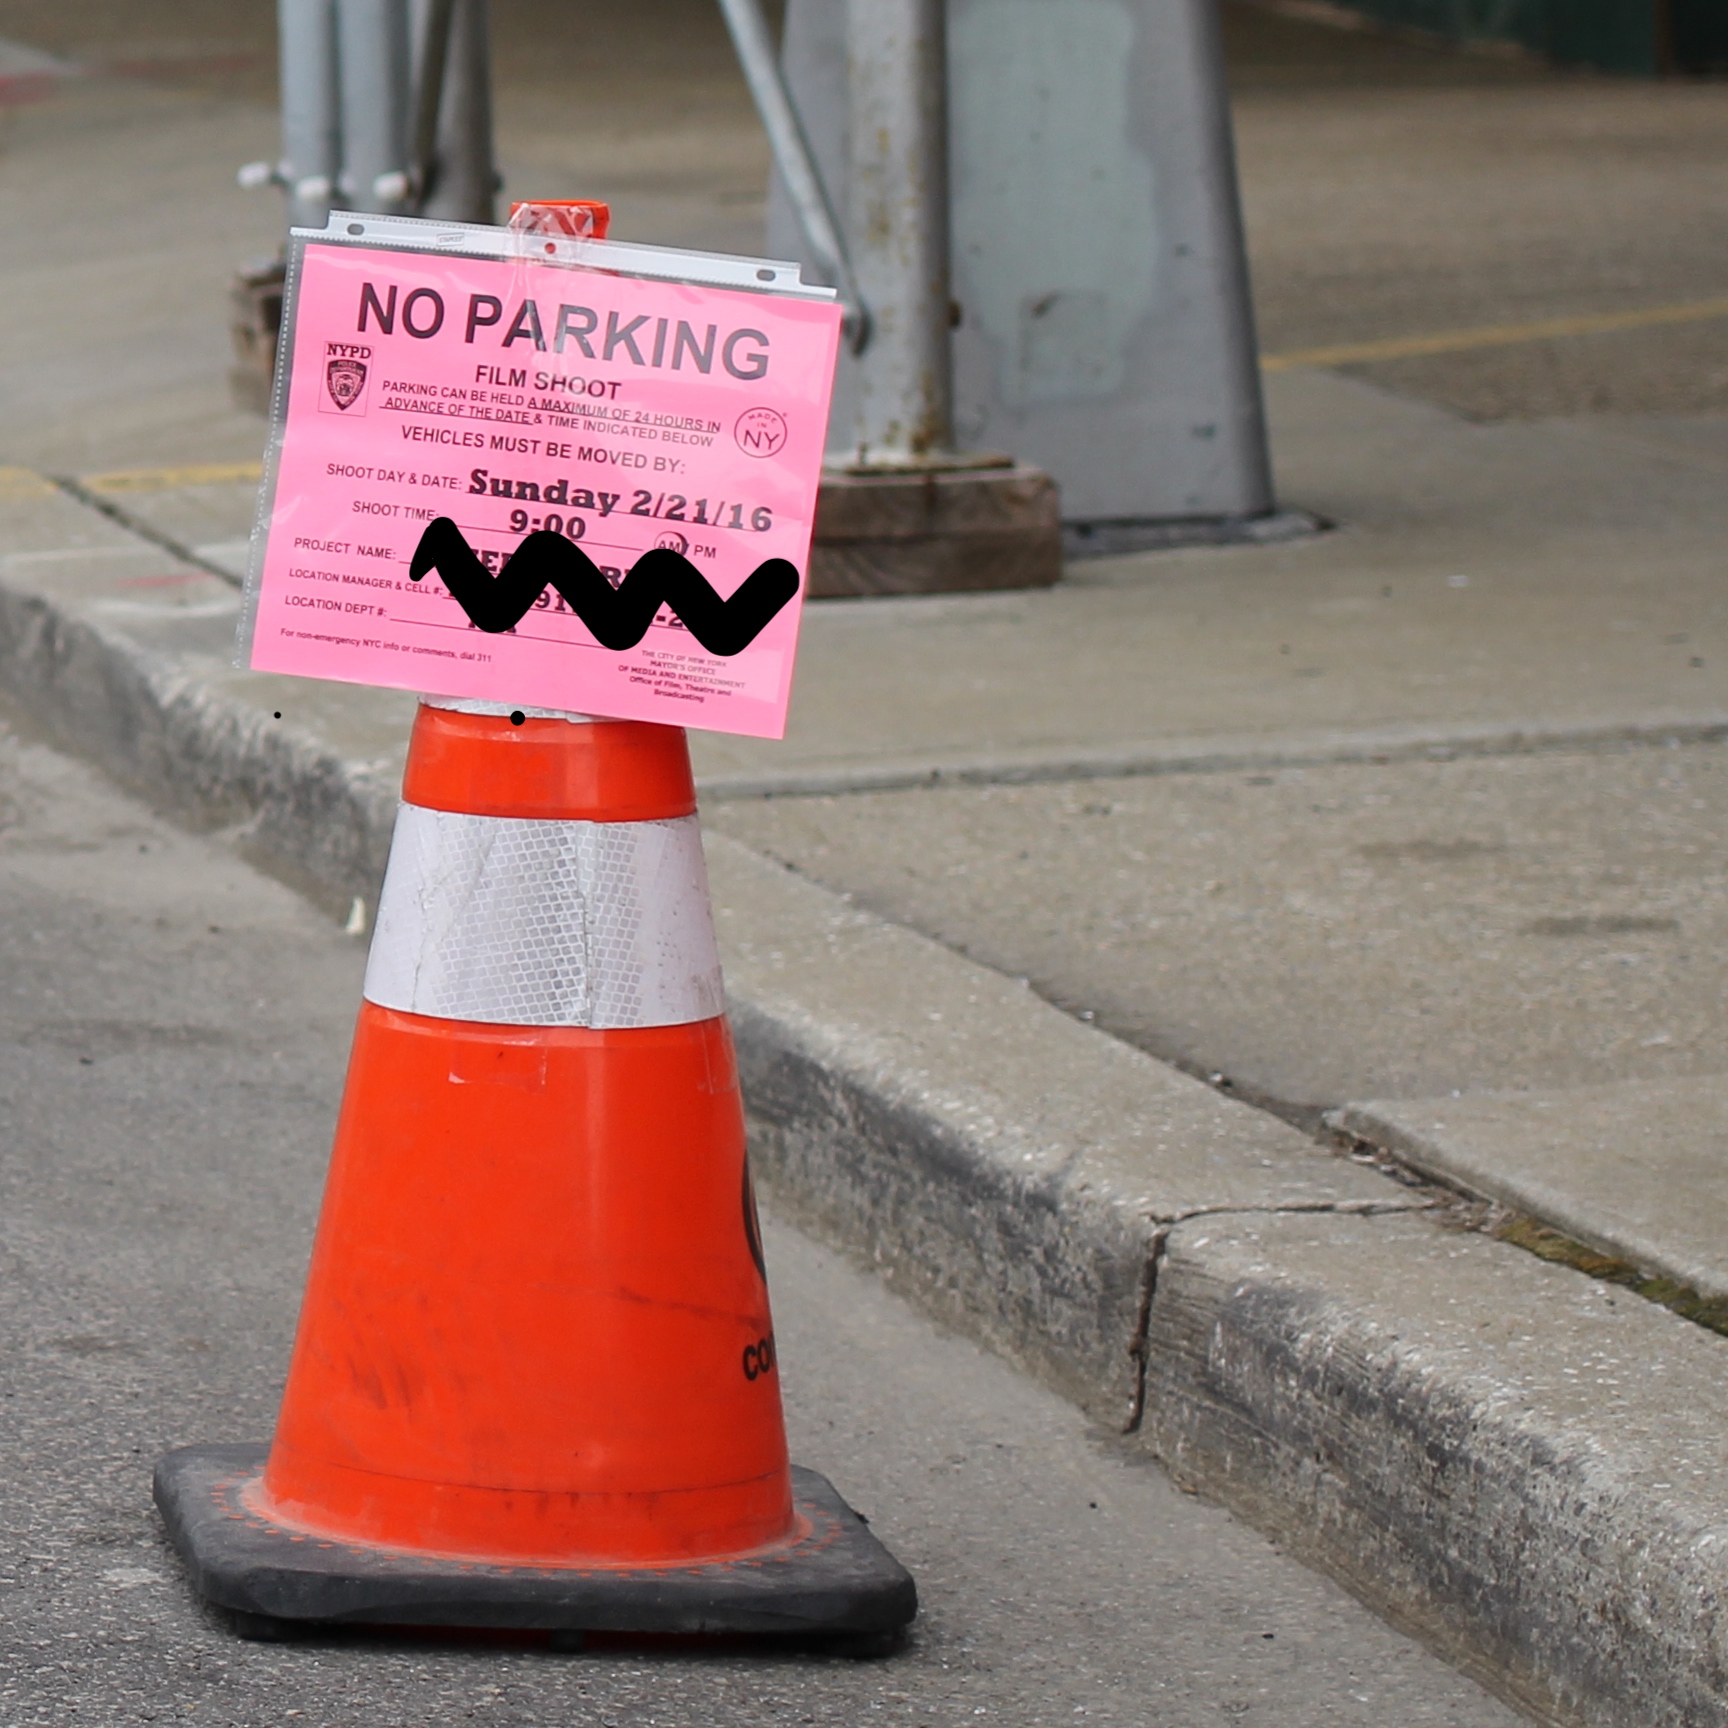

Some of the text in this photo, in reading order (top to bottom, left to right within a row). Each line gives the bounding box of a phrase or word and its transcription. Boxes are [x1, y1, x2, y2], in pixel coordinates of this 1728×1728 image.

[357, 282, 770, 381] NO PARKING
[327, 343, 372, 359] NYPD
[475, 364, 622, 400] FILM SHOOT
[382, 380, 721, 433] PARKING CAN BE HELD A MAXIMUM OF 24 HOURS IN
[747, 412, 777, 423] MADE
[385, 397, 714, 447] ADVANCE OF THE DATE & TIME INDICATED BELOW
[401, 425, 686, 474] VEHICLES MUST BE MOVED BY:
[743, 429, 780, 450] NY
[326, 463, 773, 532] SHOOT DAY & DATE: Sunday 2/21/16
[352, 500, 400, 517] SHOOT
[404, 507, 440, 521] TIME:
[510, 509, 586, 540] 9:00
[693, 544, 717, 559] PM
[294, 537, 396, 560] PROJECT NAME:
[289, 568, 340, 583] LOCATION
[342, 575, 392, 590] MANAGER
[395, 581, 402, 591] &
[405, 583, 430, 595] CELL
[433, 587, 443, 597] #:
[285, 595, 388, 618] LOCATION DEPT #:
[281, 627, 294, 637] For
[296, 631, 360, 647] non-emergency
[362, 639, 382, 649] NYC
[383, 641, 399, 651] info
[412, 646, 458, 660] comments,
[460, 651, 475, 661] dial
[477, 653, 492, 663] 311
[641, 650, 656, 658] THE
[657, 652, 675, 661] CITY
[688, 656, 705, 664] NEW
[707, 659, 727, 667] YORK
[650, 660, 717, 675] MAYOR'S OFFICE
[629, 675, 652, 685] Office
[685, 683, 715, 694] Theatre
[631, 667, 657, 676] MEDIA
[659, 670, 676, 679] AND
[678, 673, 746, 689] ENTERTAINMENT
[654, 689, 705, 703] Broadcasting
